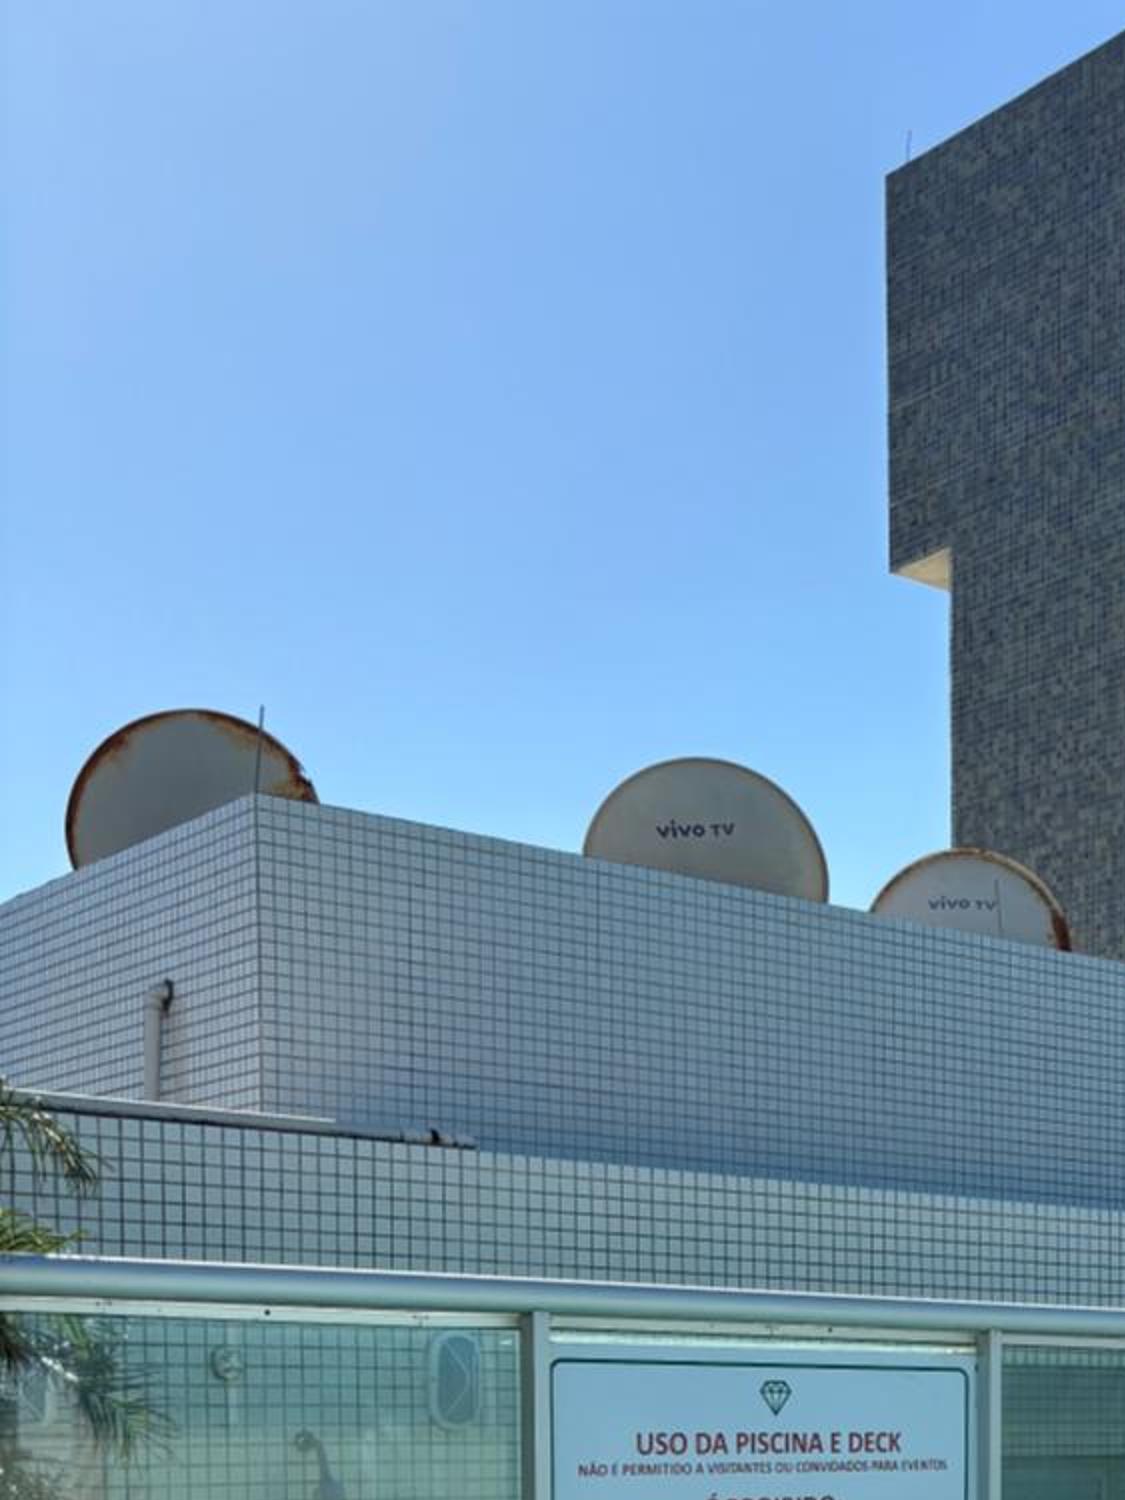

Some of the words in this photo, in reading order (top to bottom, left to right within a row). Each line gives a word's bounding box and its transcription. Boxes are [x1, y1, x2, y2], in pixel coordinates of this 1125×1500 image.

[656, 819, 706, 840] vivo
[711, 822, 735, 838] TV
[928, 895, 970, 911] vivo
[975, 900, 998, 913] TV
[636, 1431, 688, 1456] USO
[695, 1431, 728, 1455] DA
[736, 1431, 823, 1455] PISCINA
[831, 1431, 842, 1454] E
[848, 1431, 902, 1454] DECK
[577, 1462, 608, 1477] NÃO
[622, 1462, 693, 1477] PERMITIDO
[695, 1462, 704, 1474] A
[707, 1460, 772, 1475] VISITANTES
[775, 1461, 793, 1474] OU
[796, 1459, 868, 1474] CONVIDADOS
[871, 1459, 898, 1473] PARA
[902, 1457, 948, 1472] EVENTOS
